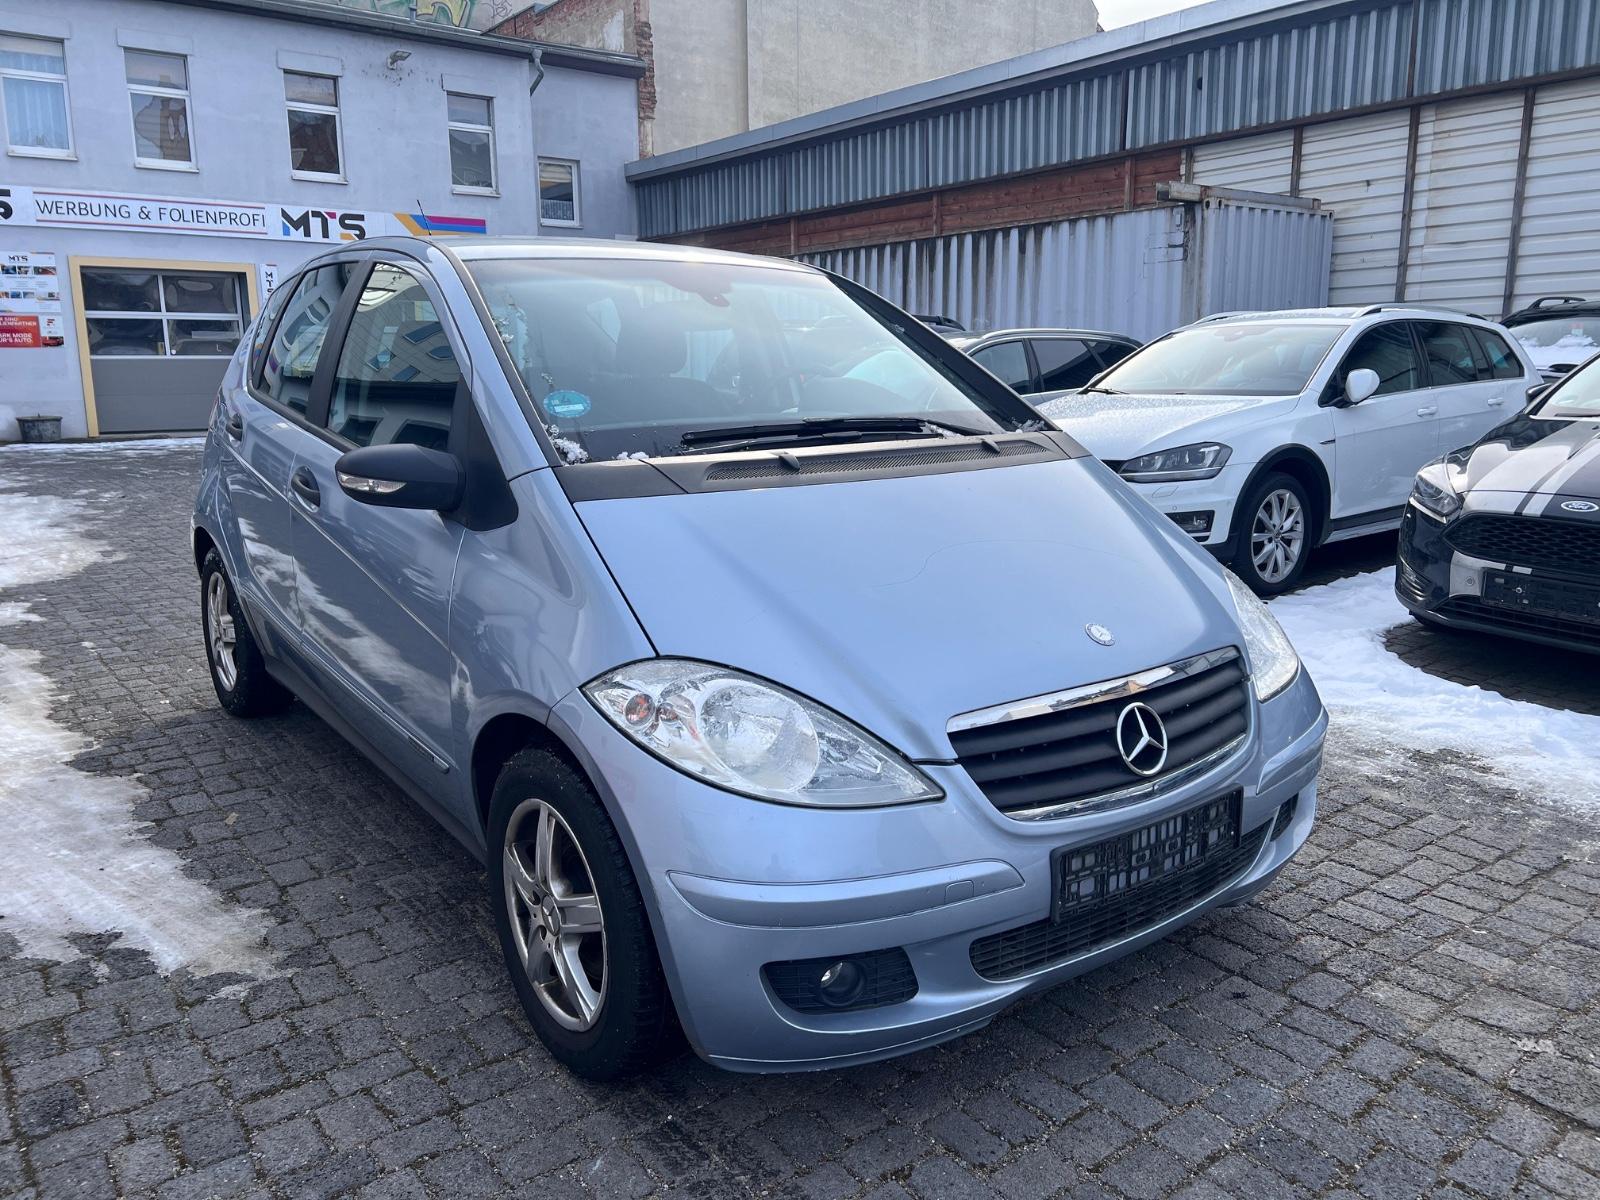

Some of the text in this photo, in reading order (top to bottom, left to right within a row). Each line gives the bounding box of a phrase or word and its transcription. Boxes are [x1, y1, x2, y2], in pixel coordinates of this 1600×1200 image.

[35, 199, 131, 219] WERBUNG
[138, 205, 152, 220] &
[158, 207, 266, 227] FOLIENPROFI
[280, 207, 366, 241] MTS
